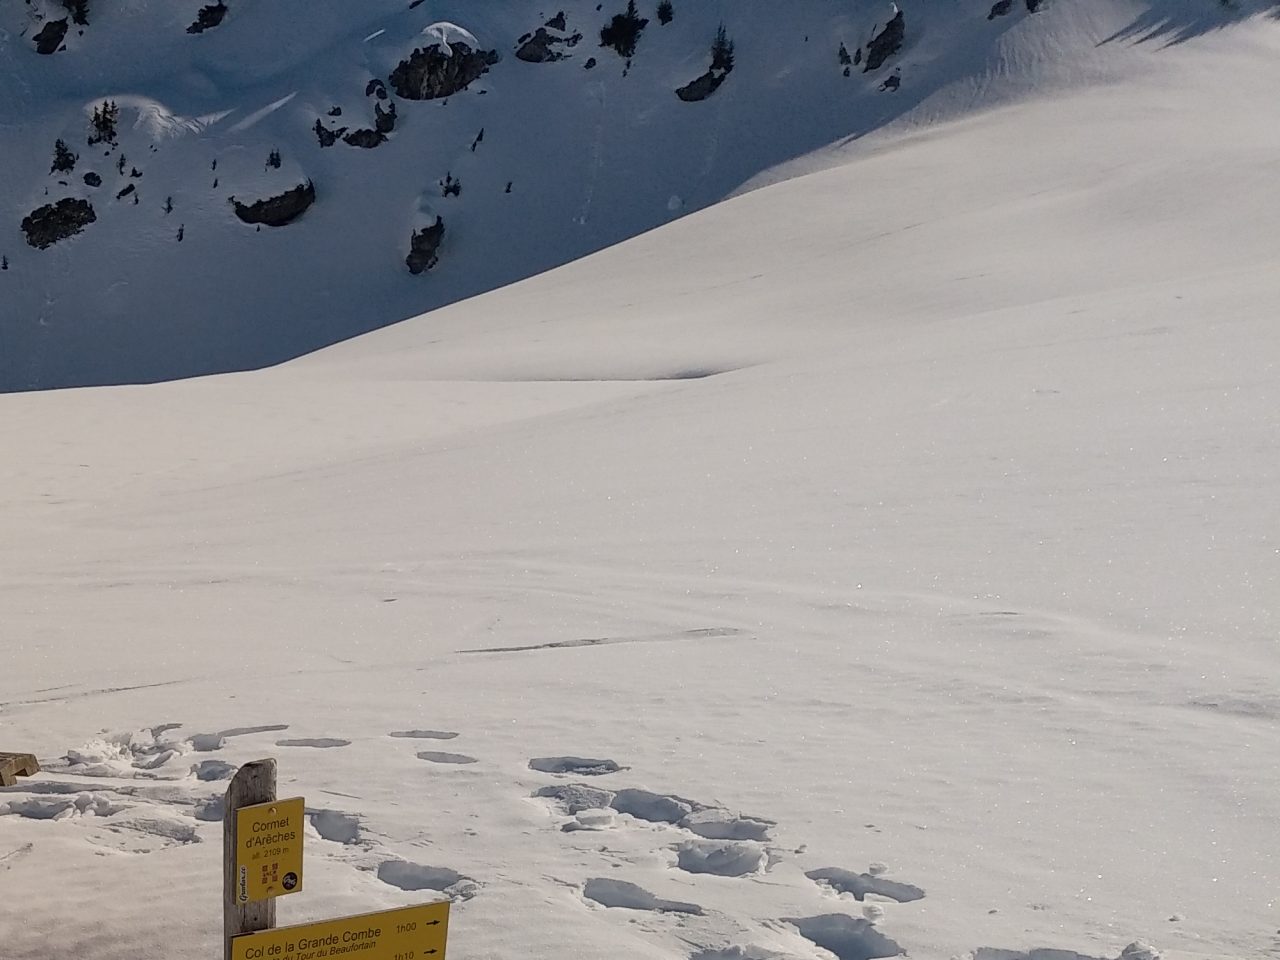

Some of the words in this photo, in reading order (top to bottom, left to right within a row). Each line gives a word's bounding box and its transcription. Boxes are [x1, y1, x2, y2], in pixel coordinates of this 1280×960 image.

[252, 817, 289, 832] Cormet
[246, 831, 296, 848] d'Arêches
[264, 849, 281, 858] 2109
[245, 947, 264, 959] Col
[267, 943, 281, 956] de
[285, 941, 295, 952] la
[298, 934, 339, 951] Grande
[342, 927, 381, 943] Combe
[396, 922, 417, 934] 1h00
[317, 948, 328, 958] du
[329, 940, 376, 956] Beaufortain
